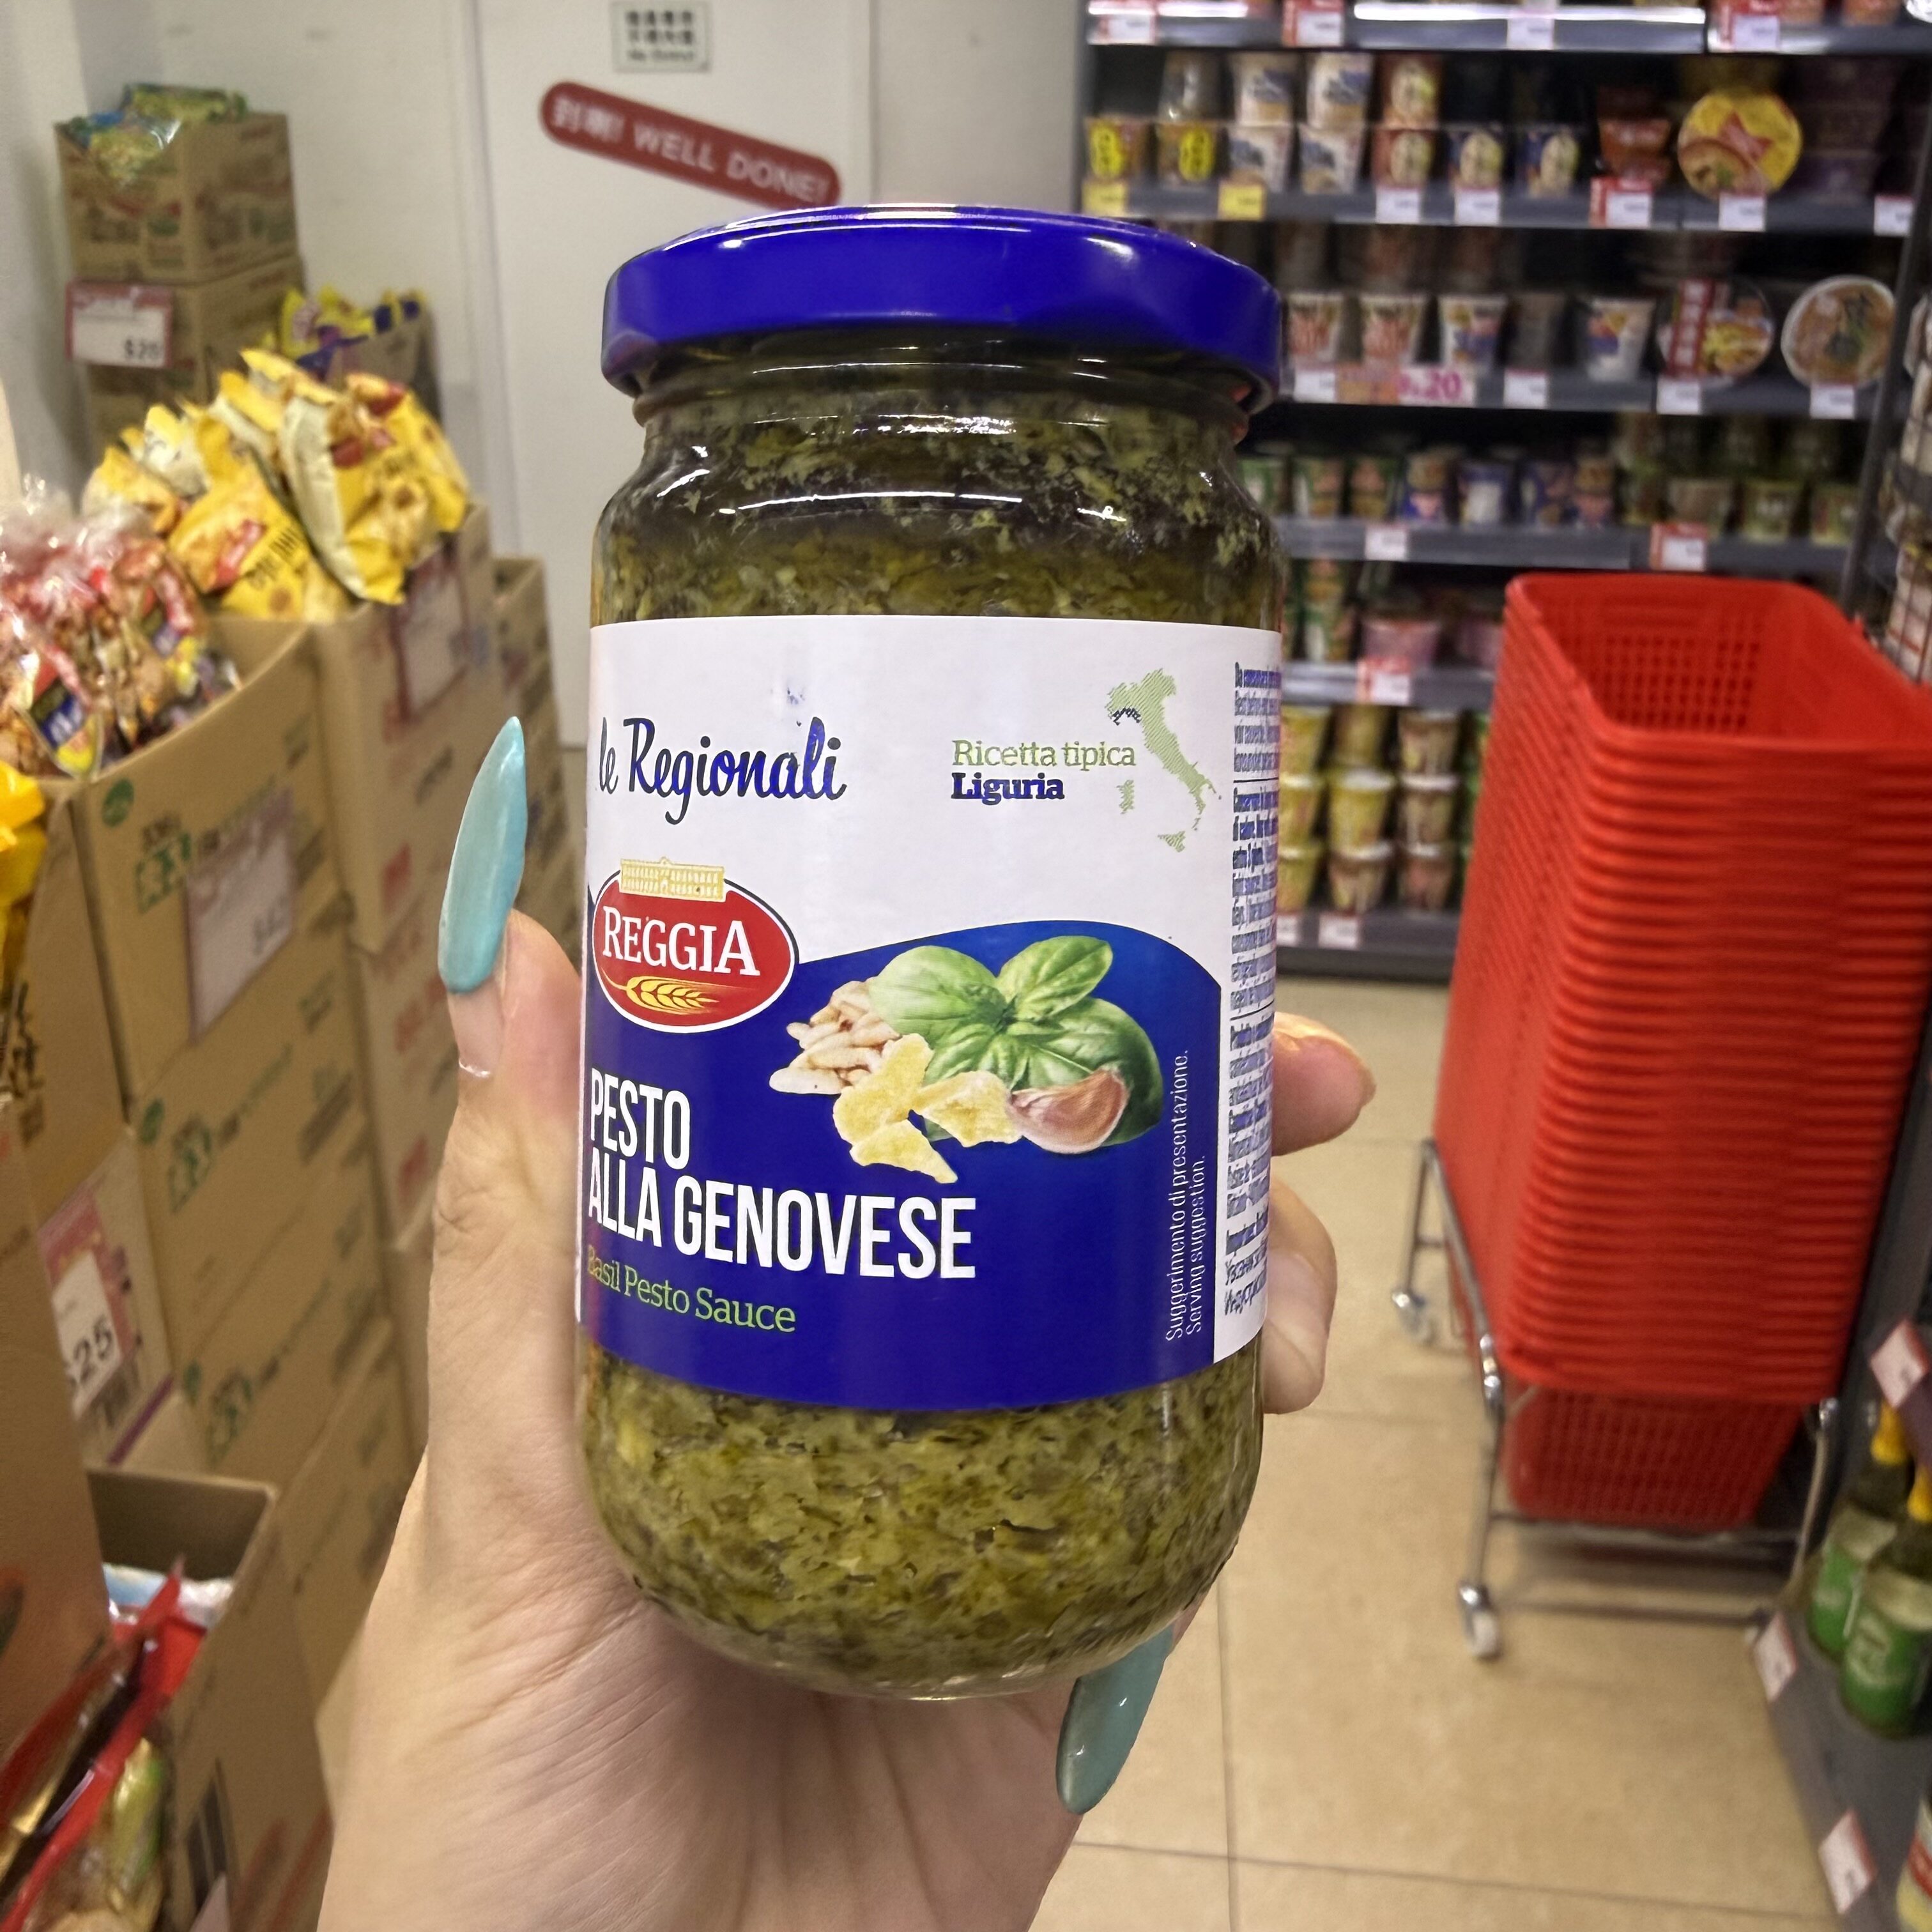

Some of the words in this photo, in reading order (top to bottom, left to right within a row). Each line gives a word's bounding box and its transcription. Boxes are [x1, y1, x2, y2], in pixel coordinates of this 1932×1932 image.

[633, 119, 716, 172] WELL
[726, 150, 831, 204] DONE!
[599, 716, 619, 795] le
[623, 716, 848, 825] Regionali
[950, 772, 1066, 806] Liguria
[951, 739, 1058, 767] Ricetta
[1061, 741, 1137, 772] tipica
[602, 905, 761, 976] REGGIA
[590, 1068, 691, 1170] PESTO
[1170, 1050, 1189, 1186] presentazione.
[587, 1147, 663, 1248] ALLA
[673, 1174, 977, 1280] GENOVESE
[1168, 1190, 1186, 1207] di
[1188, 1155, 1207, 1262] suggestion.
[586, 1244, 621, 1293] Basil
[624, 1264, 691, 1314] Pesto
[694, 1287, 797, 1333] Sauce
[1165, 1211, 1187, 1341] Suggerimento
[1185, 1265, 1206, 1335] Serving
